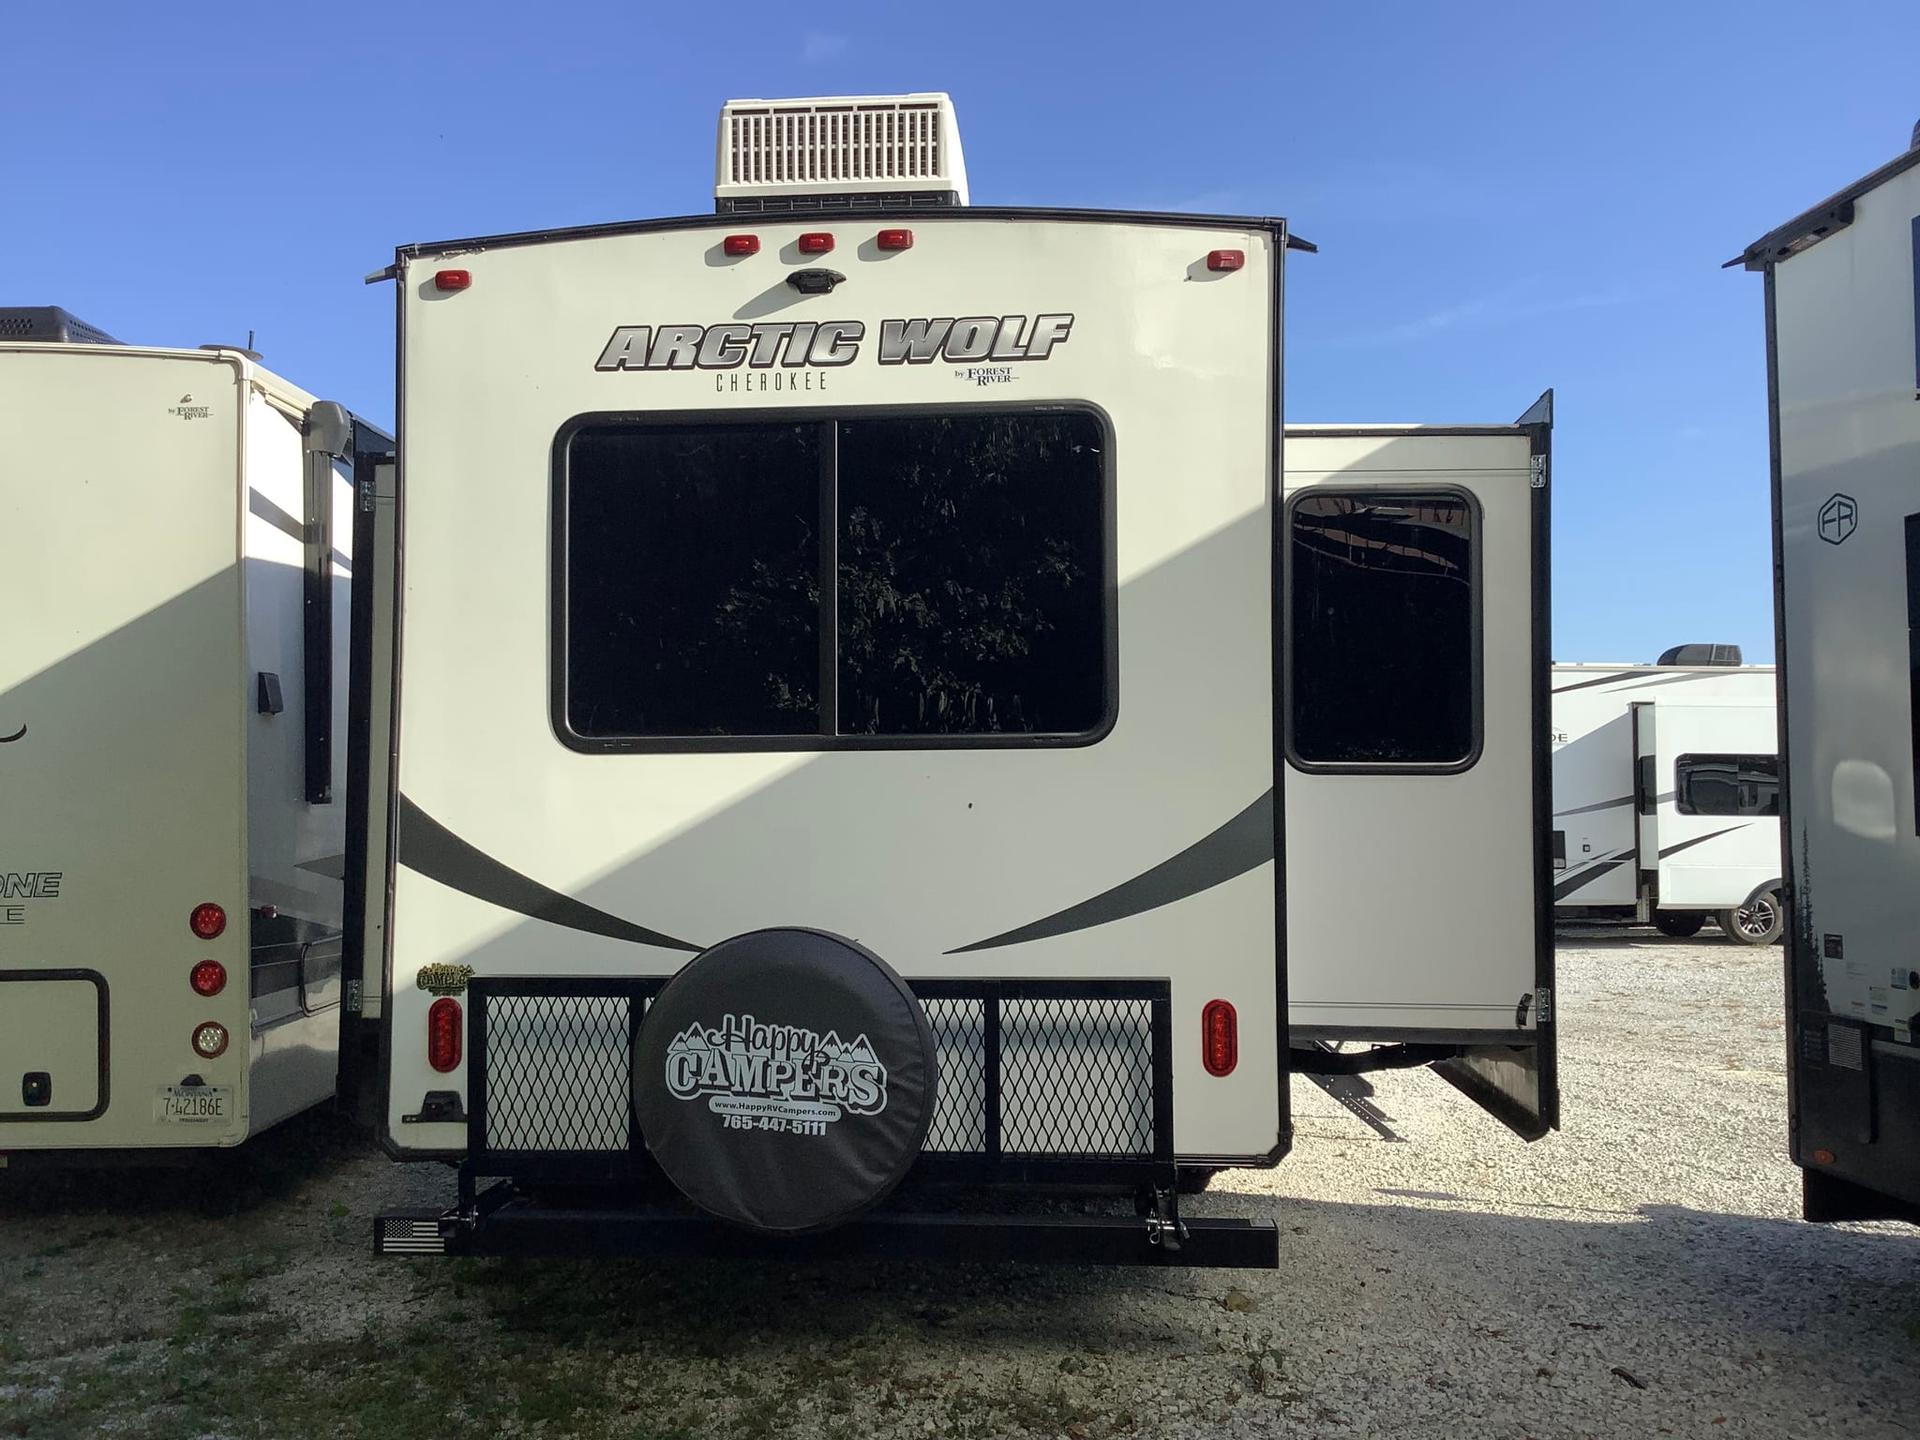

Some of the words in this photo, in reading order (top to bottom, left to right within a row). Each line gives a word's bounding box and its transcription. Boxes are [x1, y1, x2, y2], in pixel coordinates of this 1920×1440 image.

[594, 319, 865, 372] ARCTIC
[878, 313, 1075, 365] WOLF
[715, 371, 828, 393] CHEROKEE
[954, 370, 964, 378] by
[967, 367, 1012, 379] FOREST
[977, 375, 1012, 386] RIVER
[706, 1014, 830, 1073] Happy
[666, 1047, 888, 1110] CAMPERS
[714, 1100, 837, 1117] www.HappyRVCampers.com
[722, 1114, 827, 1136] 765-447-5111
